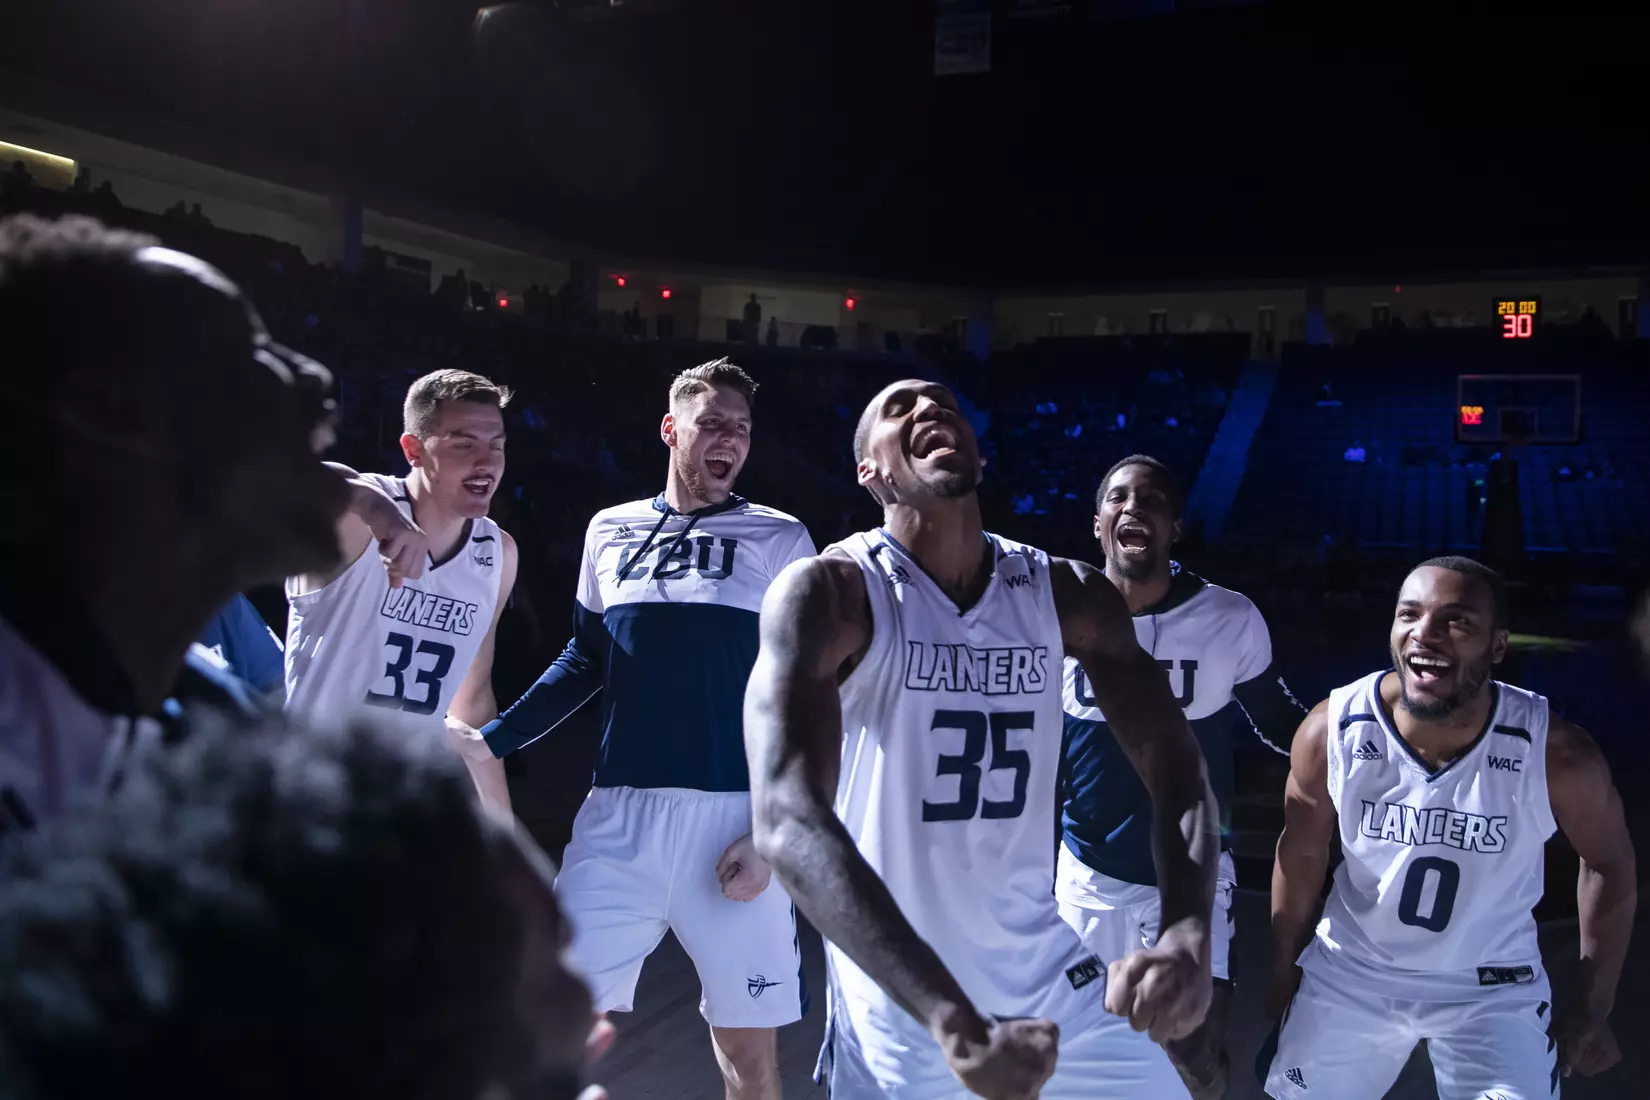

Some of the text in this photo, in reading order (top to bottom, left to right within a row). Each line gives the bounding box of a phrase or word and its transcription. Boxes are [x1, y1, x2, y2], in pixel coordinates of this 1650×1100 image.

[1503, 314, 1532, 338] 30
[615, 535, 738, 580] CBU
[1004, 574, 1032, 590] WA
[364, 631, 456, 716] 33
[922, 709, 1035, 822] 35
[1487, 755, 1522, 773] WAC
[1360, 799, 1508, 854] LANCERS
[1398, 856, 1460, 933] 0
